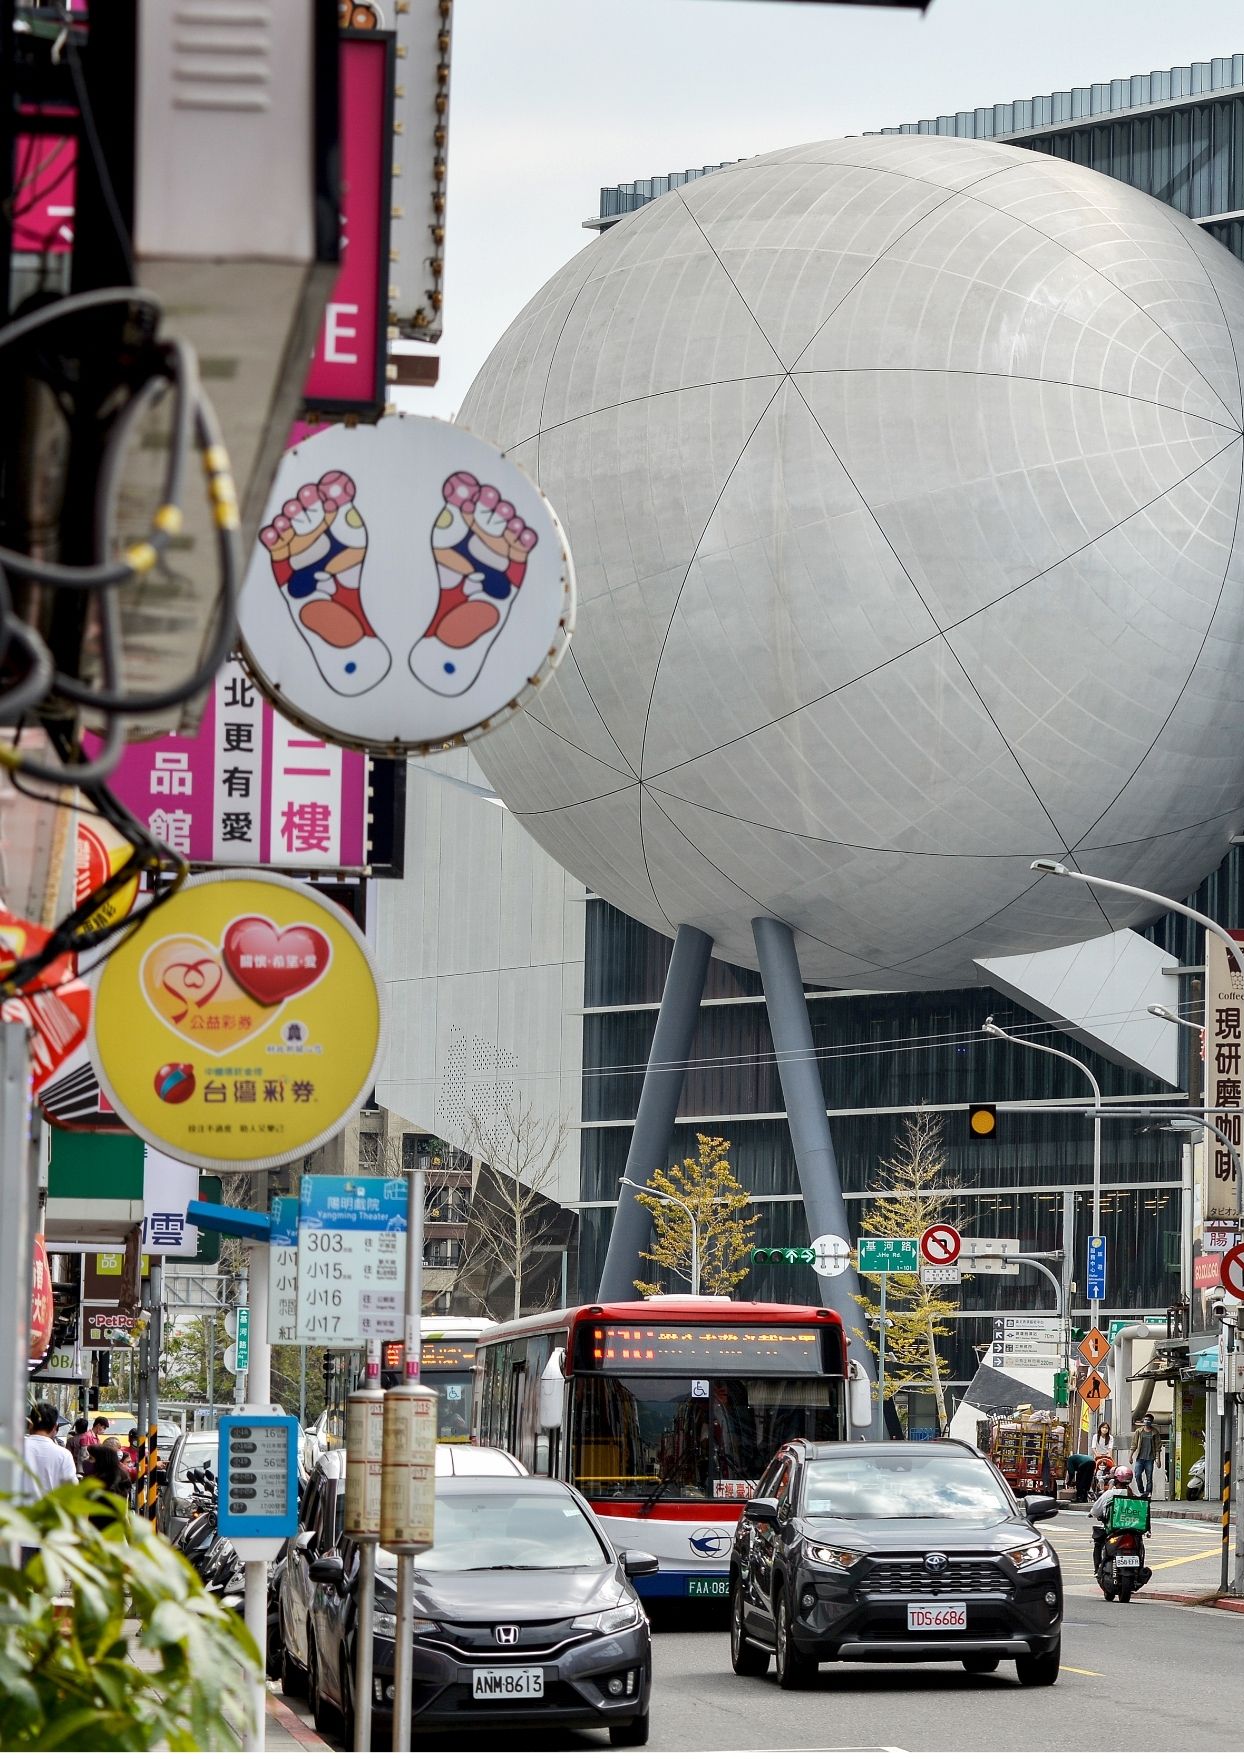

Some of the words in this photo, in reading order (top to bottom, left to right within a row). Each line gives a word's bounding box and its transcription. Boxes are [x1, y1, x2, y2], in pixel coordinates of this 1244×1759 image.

[149, 730, 193, 855] 品館
[280, 738, 332, 853] 二樓
[190, 1015, 254, 1031] 公益彩券
[1214, 1007, 1241, 1182] 現研磨咖啡
[316, 1211, 356, 1222] Yangming
[359, 1212, 389, 1221] Theater
[307, 1232, 343, 1254] 303
[865, 1241, 912, 1252] 基河路
[276, 1250, 297, 1266] 小1
[306, 1262, 343, 1280] 小15
[276, 1275, 297, 1291] 小1
[306, 1288, 342, 1307] 小16
[96, 1314, 136, 1327] PetPa
[305, 1315, 341, 1333] 小17
[909, 1610, 966, 1626] TDS-6686
[475, 1675, 542, 1694] ANM-8613
